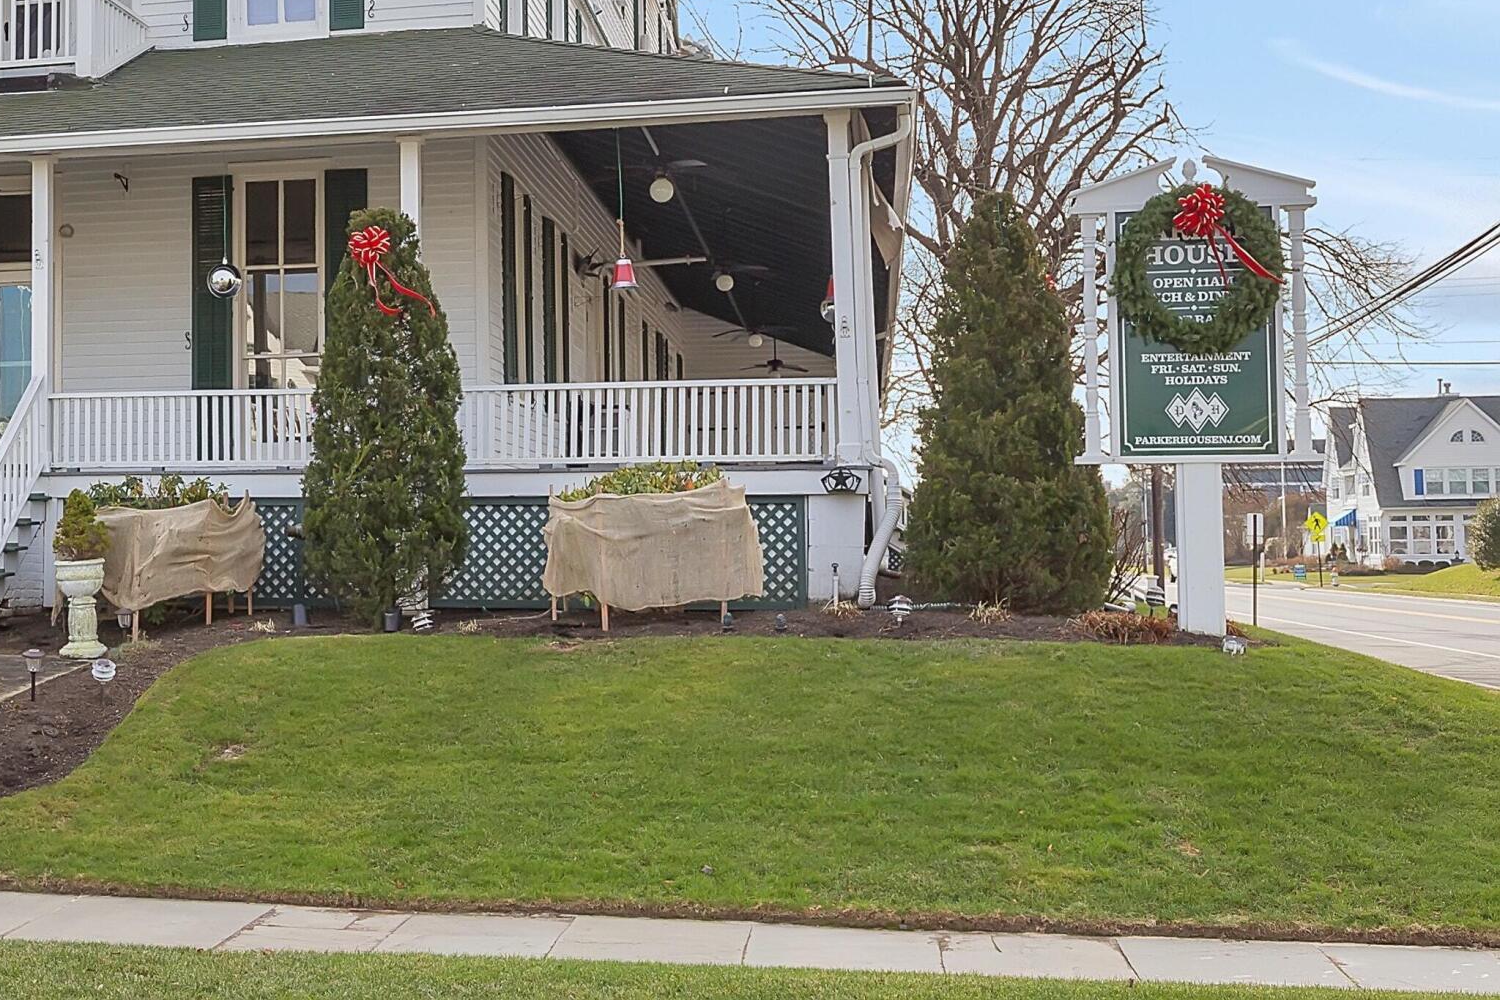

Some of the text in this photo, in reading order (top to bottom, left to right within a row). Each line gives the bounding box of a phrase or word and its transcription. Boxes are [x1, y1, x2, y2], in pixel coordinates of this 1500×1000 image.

[1153, 277, 1194, 289] OPEN
[1184, 292, 1196, 302] &
[1140, 351, 1251, 363] ENTERTAINMENT
[1164, 375, 1228, 386] HOLIDAYS
[1134, 435, 1261, 445] PARKERHOUSENJ.COM
